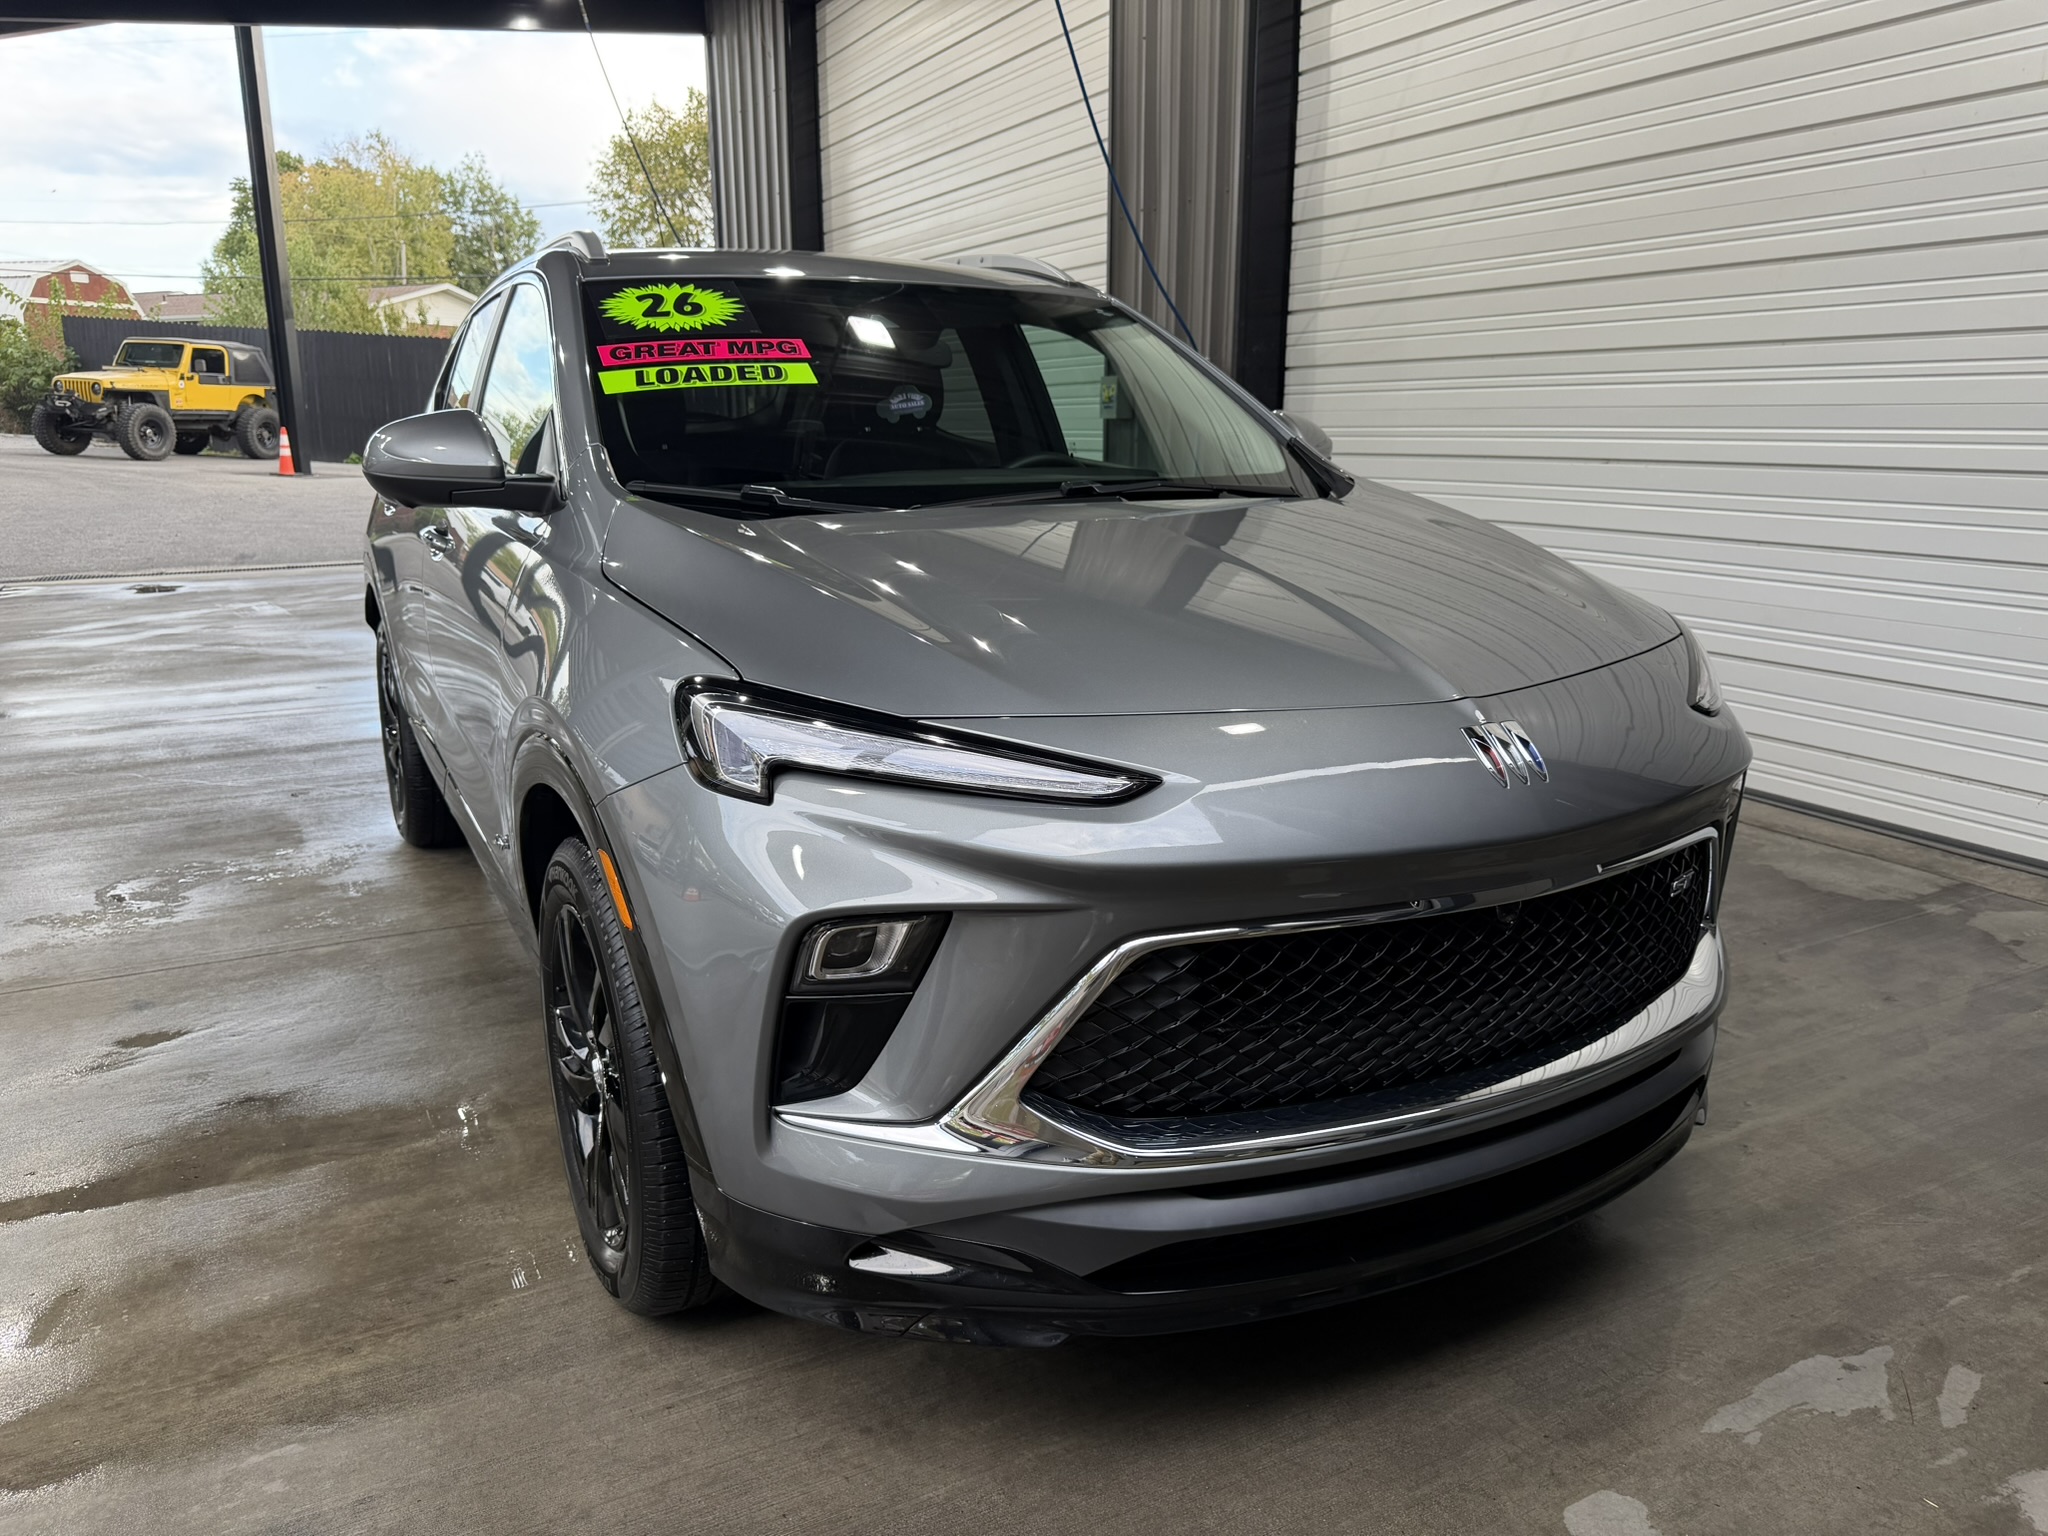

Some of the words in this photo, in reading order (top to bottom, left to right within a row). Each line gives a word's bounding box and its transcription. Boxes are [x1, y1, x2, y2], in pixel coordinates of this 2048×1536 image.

[635, 291, 706, 318] 26
[609, 340, 717, 361] GREAT
[728, 340, 800, 356] MPG
[635, 364, 786, 387] LOADED
